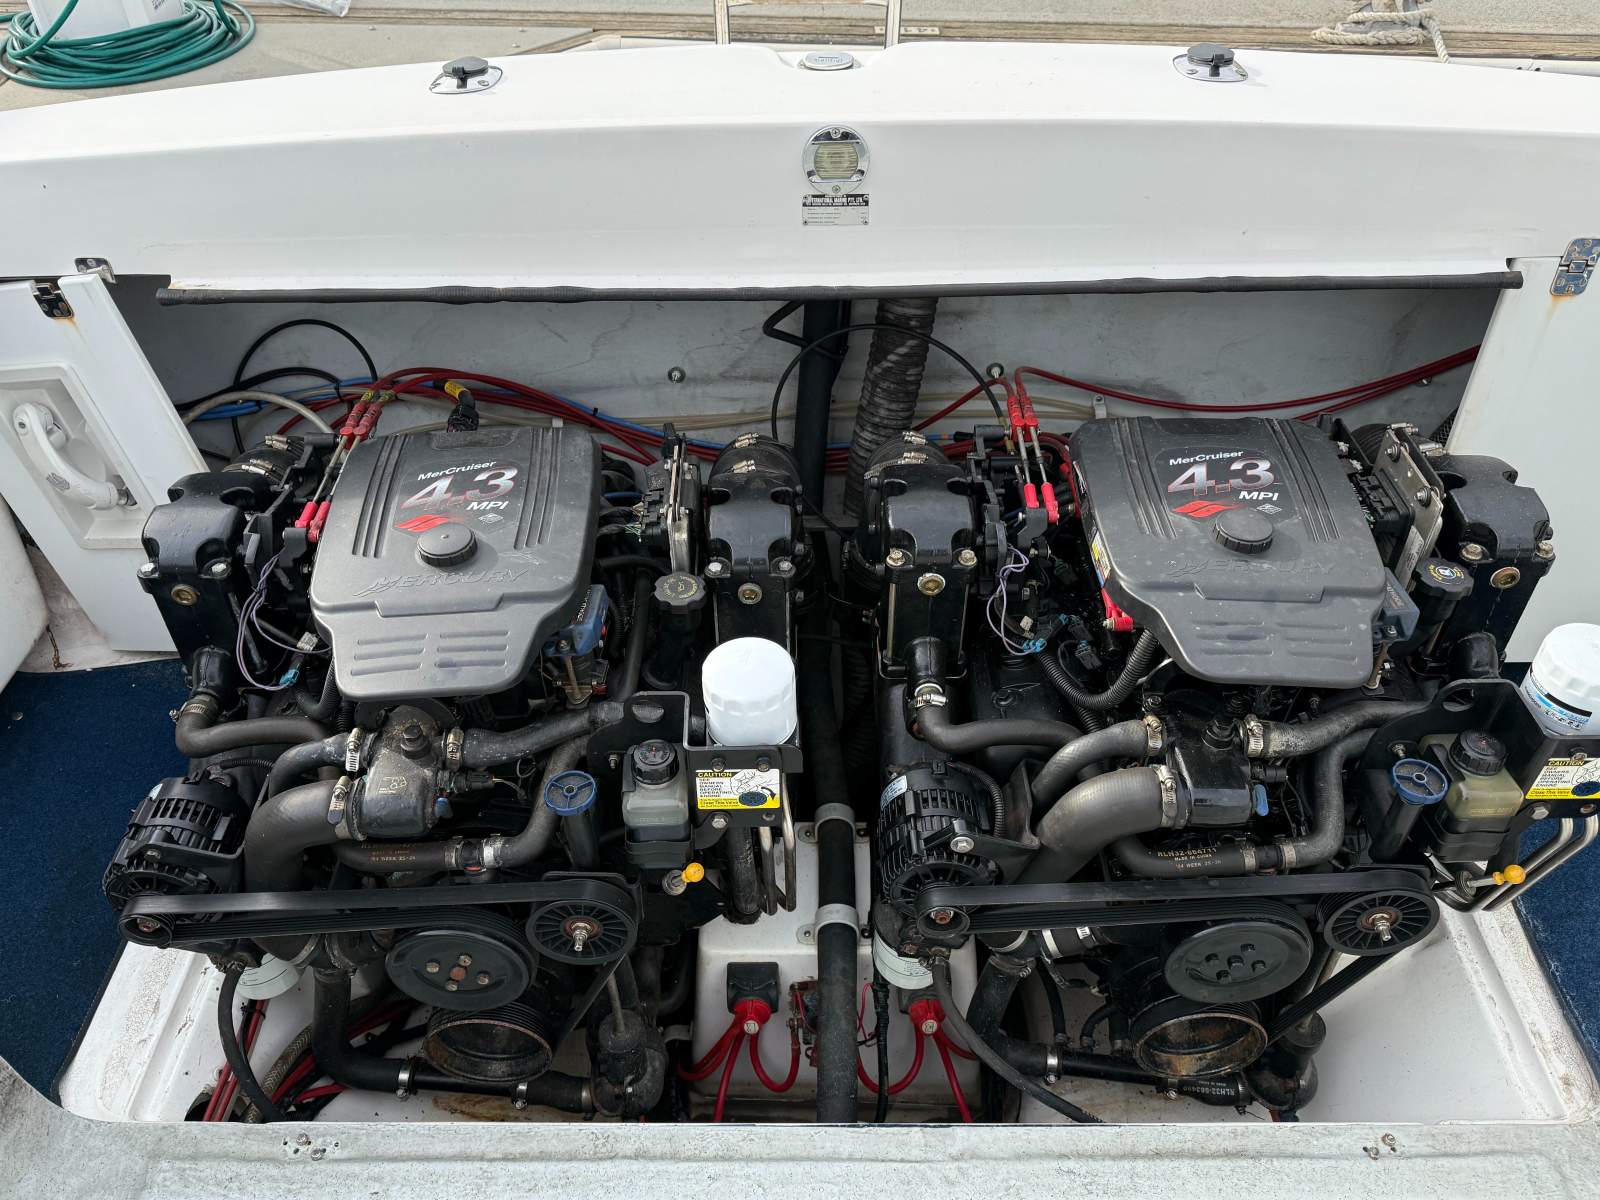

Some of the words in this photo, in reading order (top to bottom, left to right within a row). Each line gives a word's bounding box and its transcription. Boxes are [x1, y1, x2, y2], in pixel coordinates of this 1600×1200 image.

[1169, 451, 1244, 466] MerCruiser
[418, 461, 497, 481] MerCruiser
[1168, 458, 1275, 496] 4.3
[400, 466, 518, 509] 4.3
[1238, 491, 1279, 501] MPI
[466, 501, 509, 510] MPI
